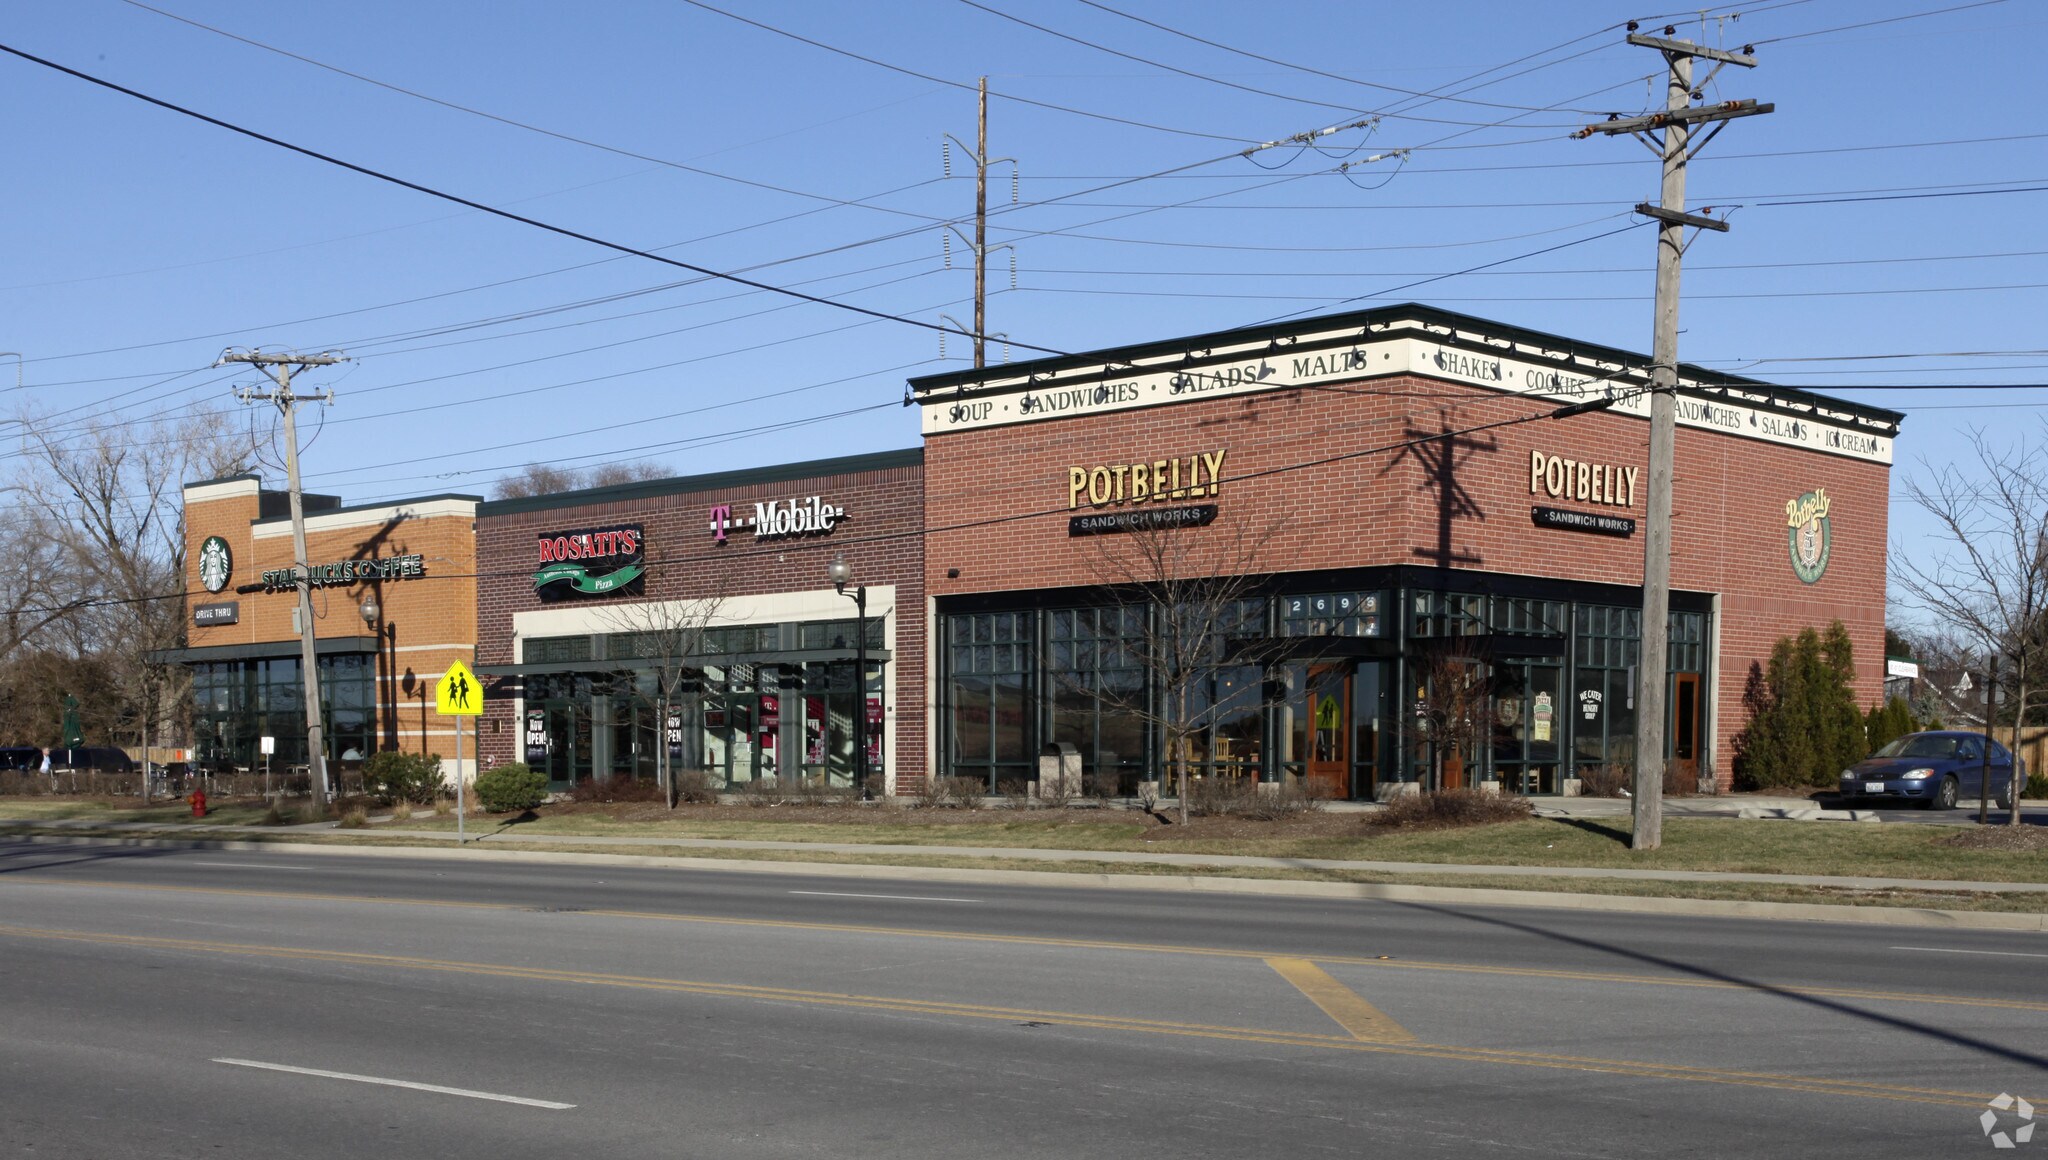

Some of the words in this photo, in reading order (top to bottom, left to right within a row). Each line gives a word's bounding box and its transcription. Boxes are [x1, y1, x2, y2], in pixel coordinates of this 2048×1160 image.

[949, 402, 993, 424] SOUP
[1020, 382, 1139, 415] SANDWICHES
[1169, 365, 1257, 396] SALADS
[1292, 350, 1368, 378] MALTS
[1439, 351, 1498, 381] SHAKES
[1526, 369, 1586, 399] COOKIES
[1611, 386, 1642, 409] SOUP
[1674, 400, 1741, 429] ANDWICHES
[1762, 416, 1808, 441] SALADS
[1842, 436, 1874, 455] CREAM
[1069, 449, 1227, 509] POTBELLY
[1531, 450, 1639, 506] POTBELLY
[1081, 513, 1149, 528] SANDWICH
[1153, 508, 1200, 524] WORKS
[1549, 511, 1596, 527] SANDWICH
[1598, 518, 1629, 531] WORKS
[1786, 488, 1831, 532] Potbelly
[539, 529, 636, 562] ROSATI'S
[359, 554, 421, 578] COFFEE
[595, 580, 613, 590] Pizza
[196, 609, 213, 619] DRIVE
[215, 608, 231, 617] THRU
